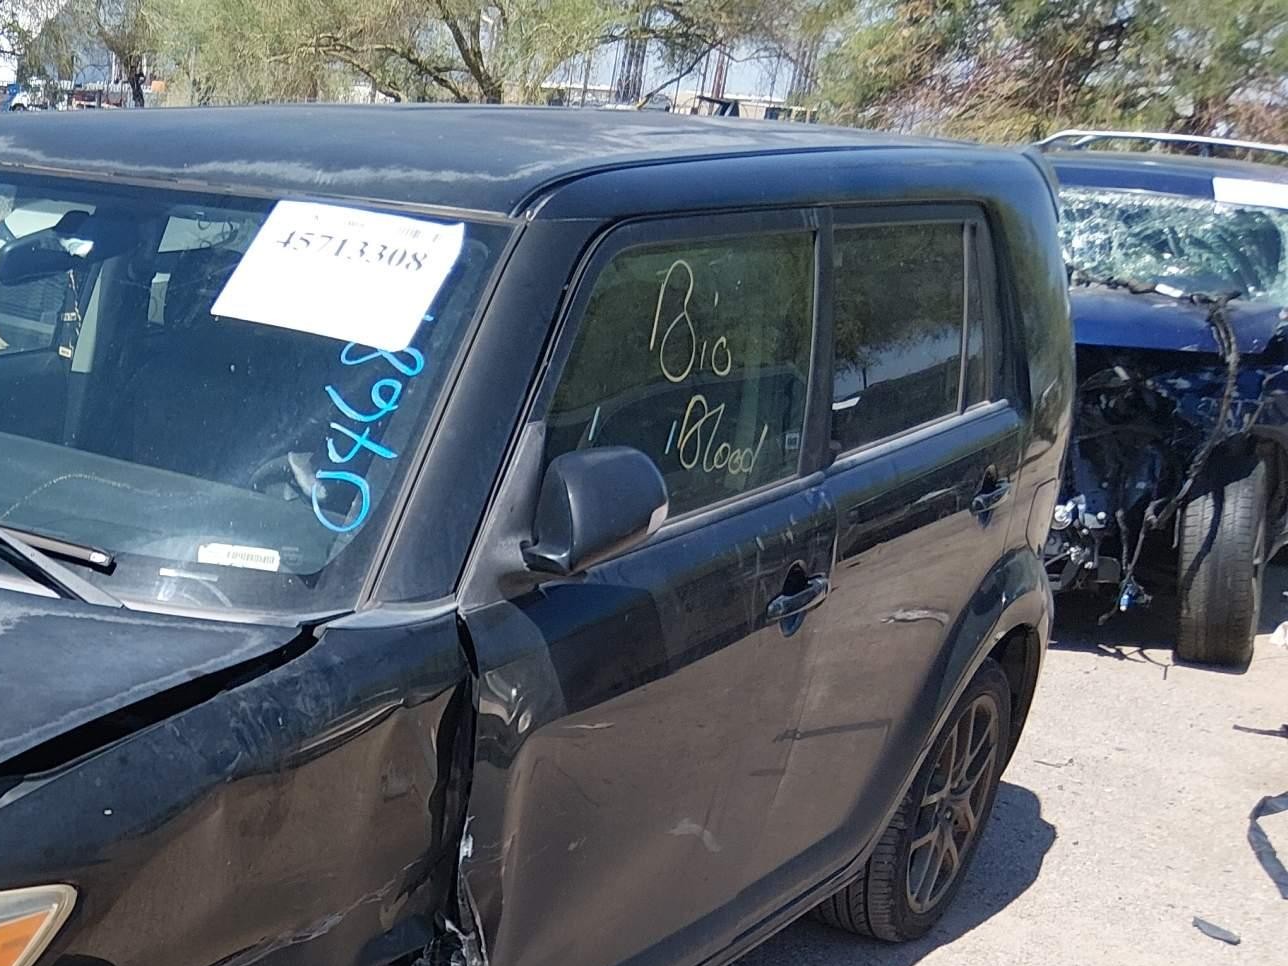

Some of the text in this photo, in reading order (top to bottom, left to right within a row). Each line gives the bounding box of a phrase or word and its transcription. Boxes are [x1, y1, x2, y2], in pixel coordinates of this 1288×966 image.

[275, 229, 428, 271] 45713308
[649, 258, 732, 383] Bio
[312, 314, 434, 532] 0468
[677, 394, 768, 475] Blood
